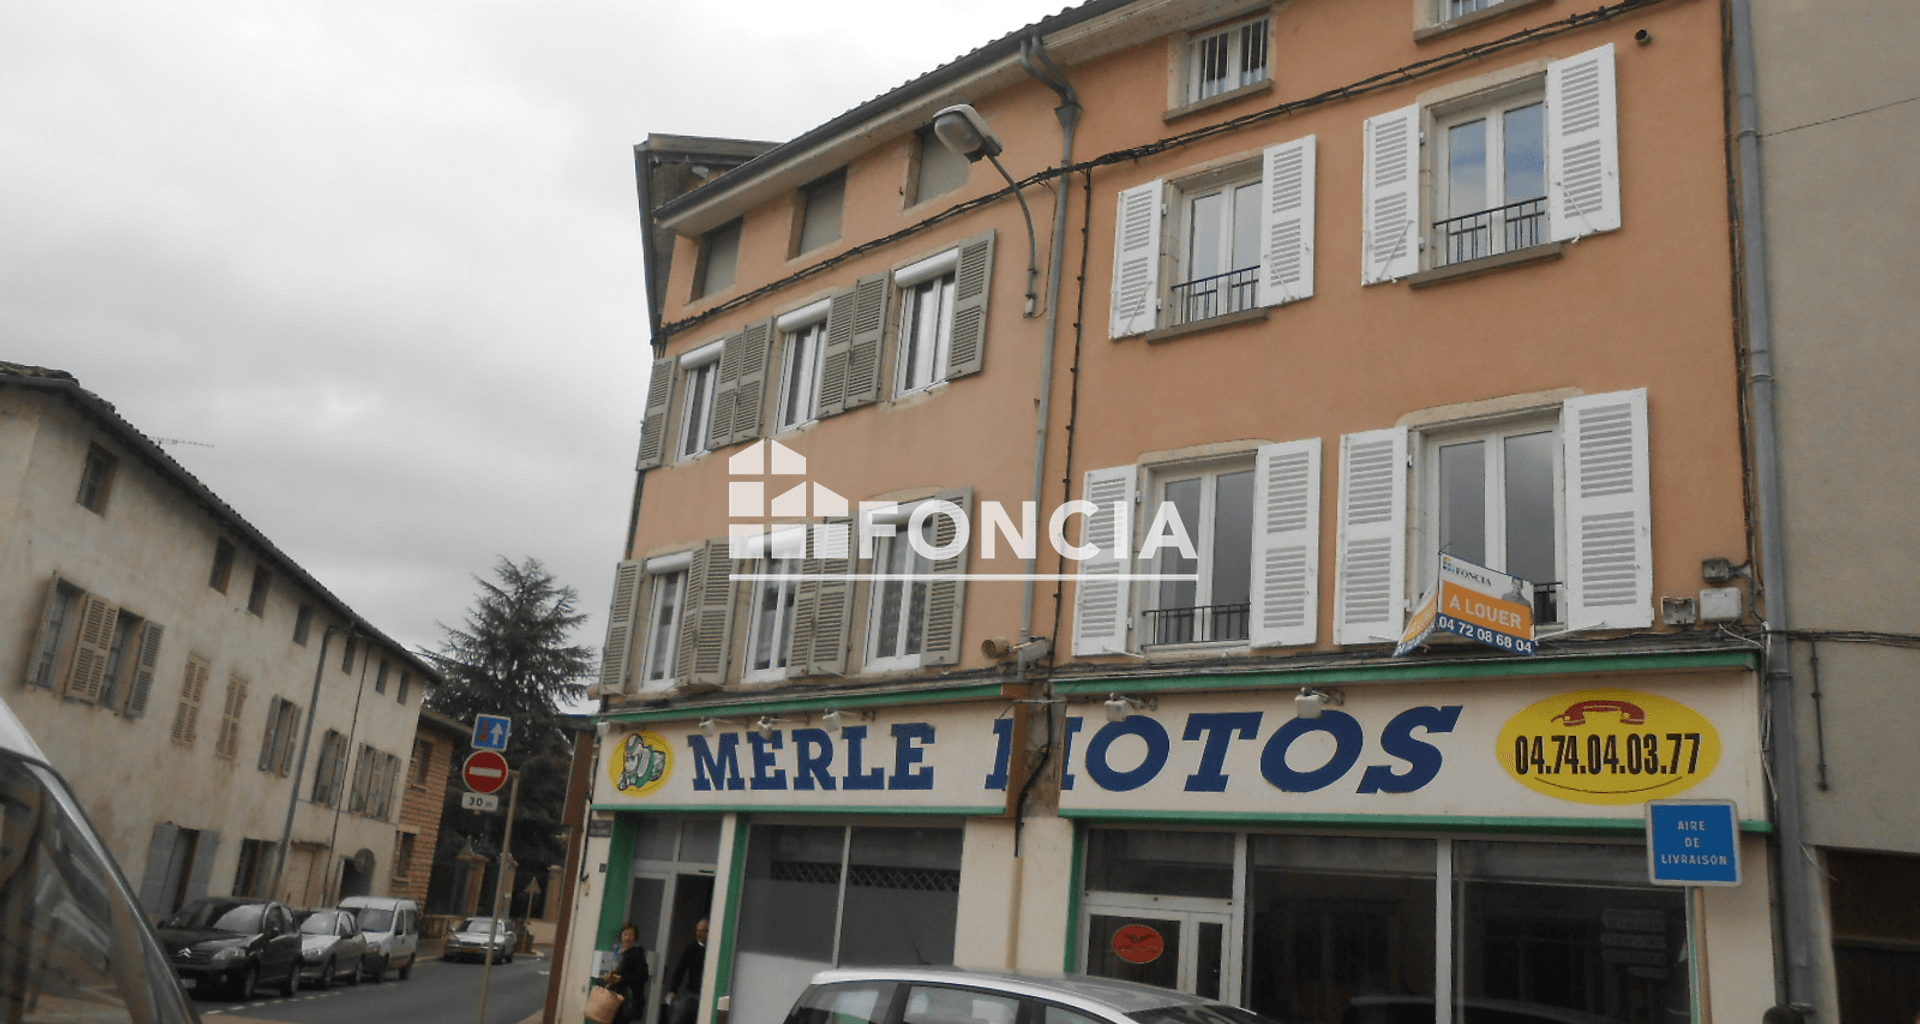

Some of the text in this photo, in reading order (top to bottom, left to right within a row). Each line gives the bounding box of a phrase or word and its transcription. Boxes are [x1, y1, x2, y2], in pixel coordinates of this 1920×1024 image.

[1455, 567, 1492, 587] FONCIA
[1449, 594, 1461, 611] A
[1465, 598, 1522, 629] LOUER
[1438, 616, 1533, 654] 04 72 08 68 04
[687, 722, 936, 791] MERLE
[1515, 733, 1701, 775] 04.74.04.03.77
[469, 796, 483, 807] 30
[1677, 820, 1705, 831] AIRE
[1684, 837, 1700, 849] DE
[1661, 854, 1727, 866] LIVRAISON
